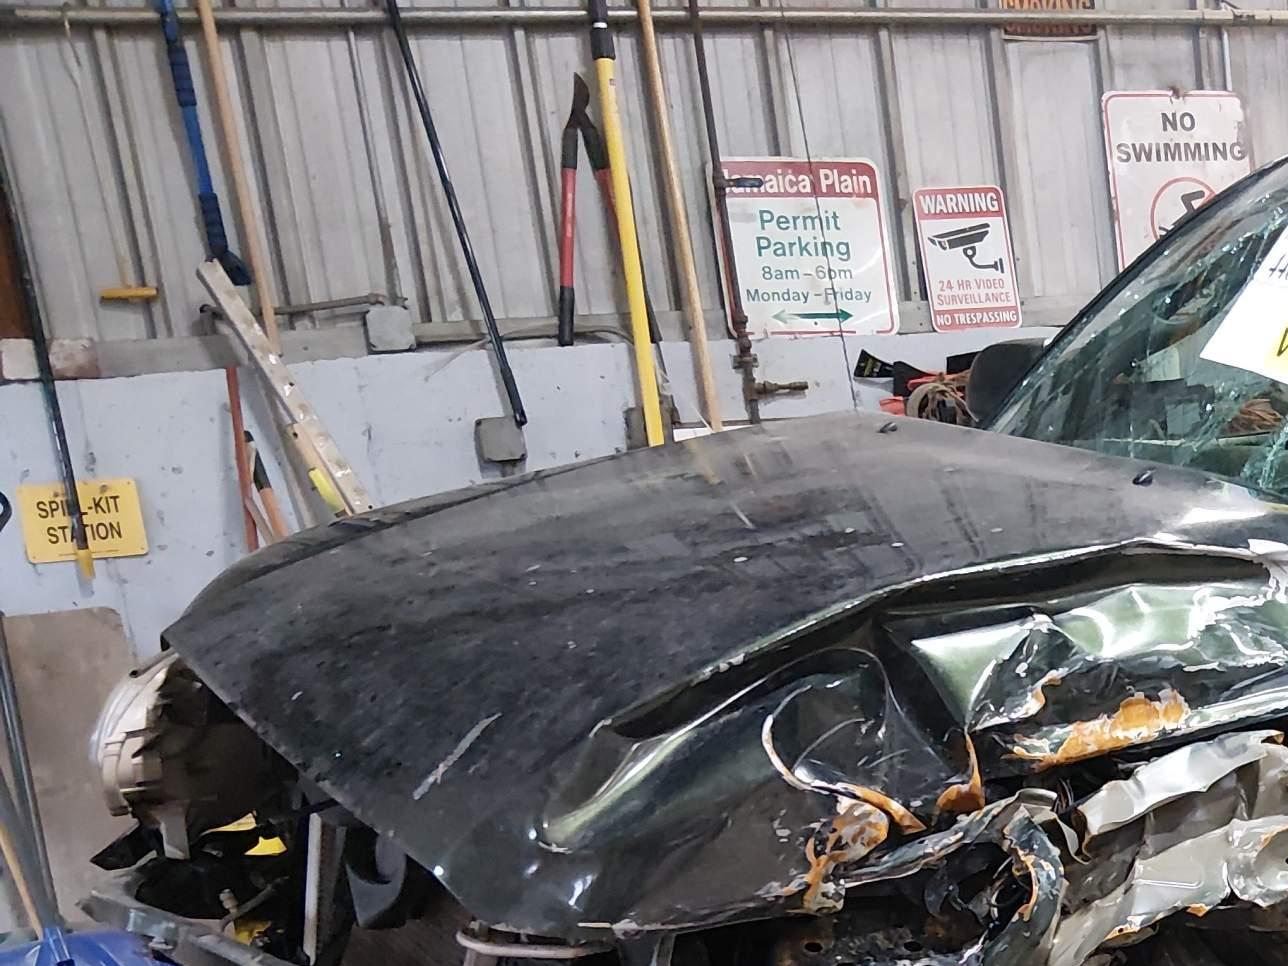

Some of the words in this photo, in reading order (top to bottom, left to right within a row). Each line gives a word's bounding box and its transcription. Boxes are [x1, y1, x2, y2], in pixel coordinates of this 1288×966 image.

[1161, 111, 1196, 132] NO
[1116, 141, 1248, 163] SWIMMING
[819, 168, 872, 194] Plain
[919, 192, 999, 215] WARNING
[759, 209, 841, 231] Permit
[755, 236, 851, 262] Parking
[746, 288, 809, 304] Monday
[824, 288, 872, 304] Friday
[939, 280, 954, 292] 24
[958, 279, 972, 291] HR
[975, 278, 1005, 290] VIDEO
[937, 292, 1012, 306] SURVEILLANCE
[936, 313, 952, 326] NO
[954, 310, 1017, 325] TRESPASSING
[36, 495, 120, 519] SPI-KIT
